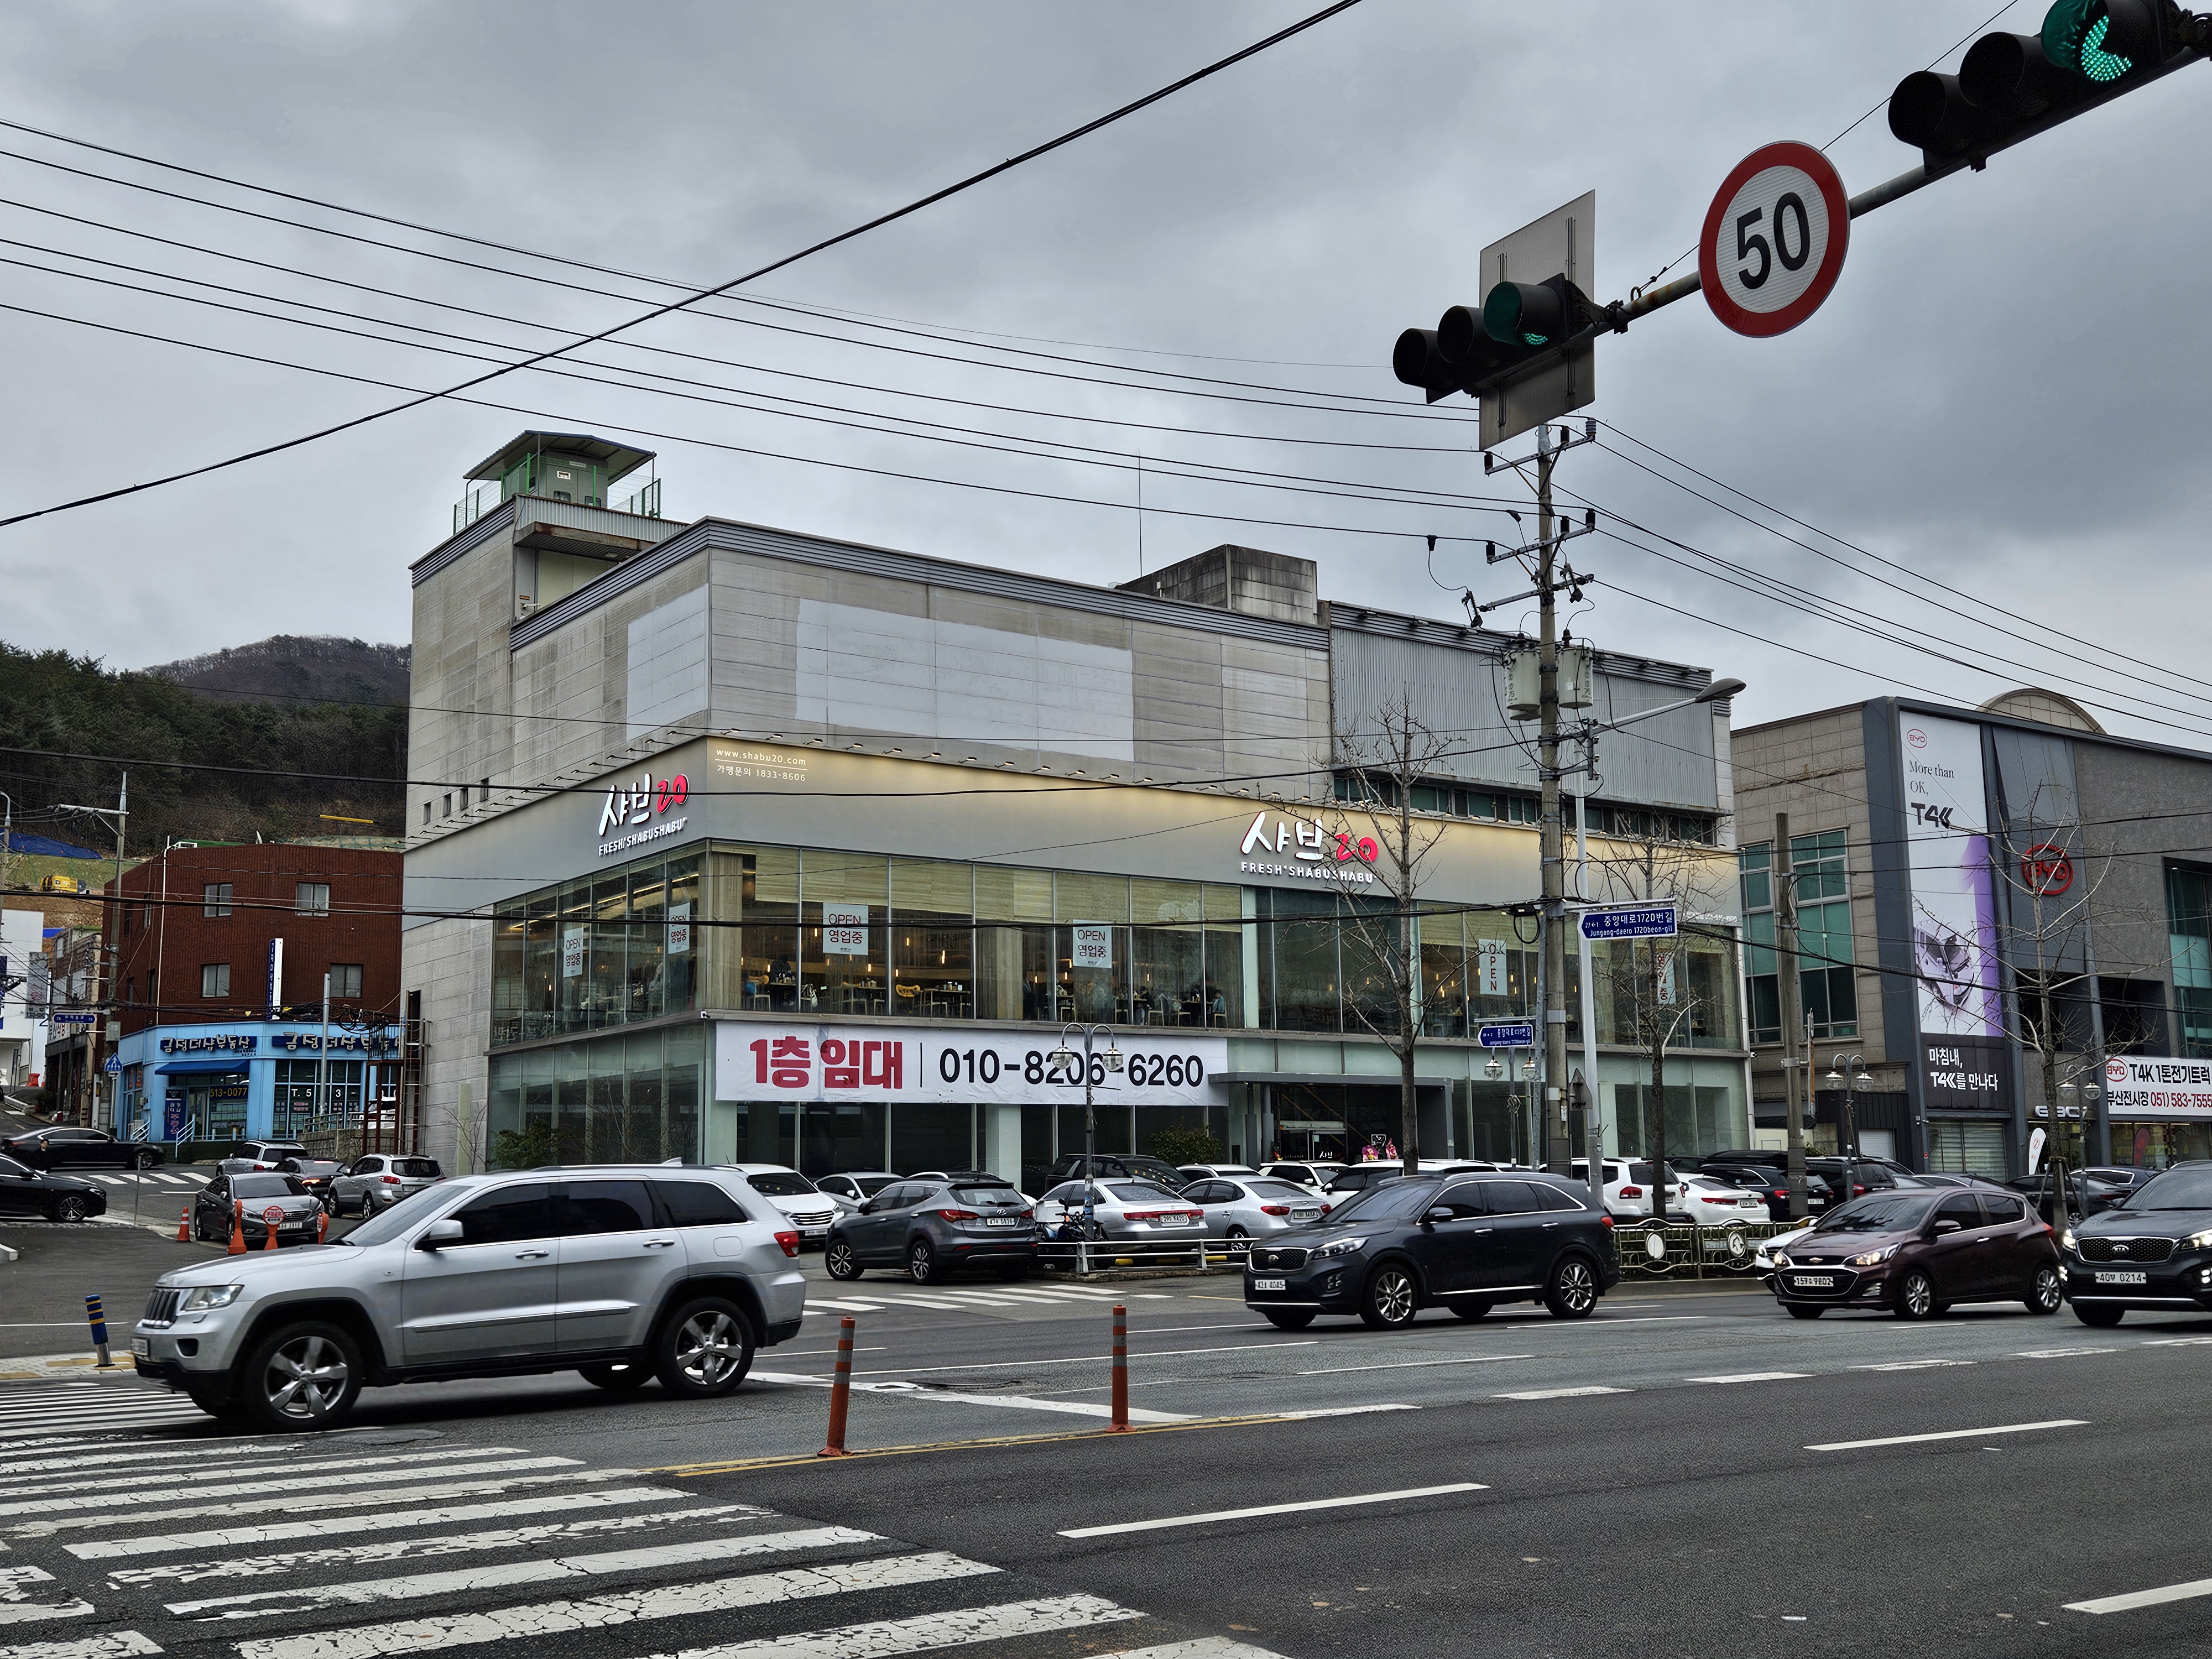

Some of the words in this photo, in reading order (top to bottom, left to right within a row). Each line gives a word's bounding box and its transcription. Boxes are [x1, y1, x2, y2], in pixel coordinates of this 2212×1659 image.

[1736, 192, 1810, 290] 50
[1910, 734, 1926, 743] BYD
[716, 749, 806, 765] www.shabu20.com
[717, 765, 751, 776] 가맹문의
[756, 769, 805, 781] 1833-8606
[1910, 760, 1932, 774] More
[1935, 764, 1954, 778] than
[1910, 780, 1928, 796] OK,
[1604, 912, 1672, 927] 중앙대로1720번길
[829, 930, 863, 944] 영업중
[1077, 930, 1105, 941] OPEN
[566, 938, 581, 950] OPEN
[1078, 945, 1107, 958] 영업중
[1489, 943, 1497, 992] OPEN
[750, 1036, 811, 1088] 1층
[820, 1039, 902, 1089] 임대
[1929, 1047, 1963, 1068] 마침내,
[940, 1048, 1203, 1087] 010-8206-6260
[2106, 1066, 2125, 1076] BYD
[2129, 1064, 2154, 1082] T4K
[1969, 1072, 1998, 1091] 만나다
[210, 1087, 247, 1097] 513-0077
[2107, 1091, 2148, 1106] 부산전시장
[2151, 1092, 2169, 1107] 051)
[2171, 1092, 2212, 1108] 583-7555
[2120, 1273, 2141, 1282] 0214
